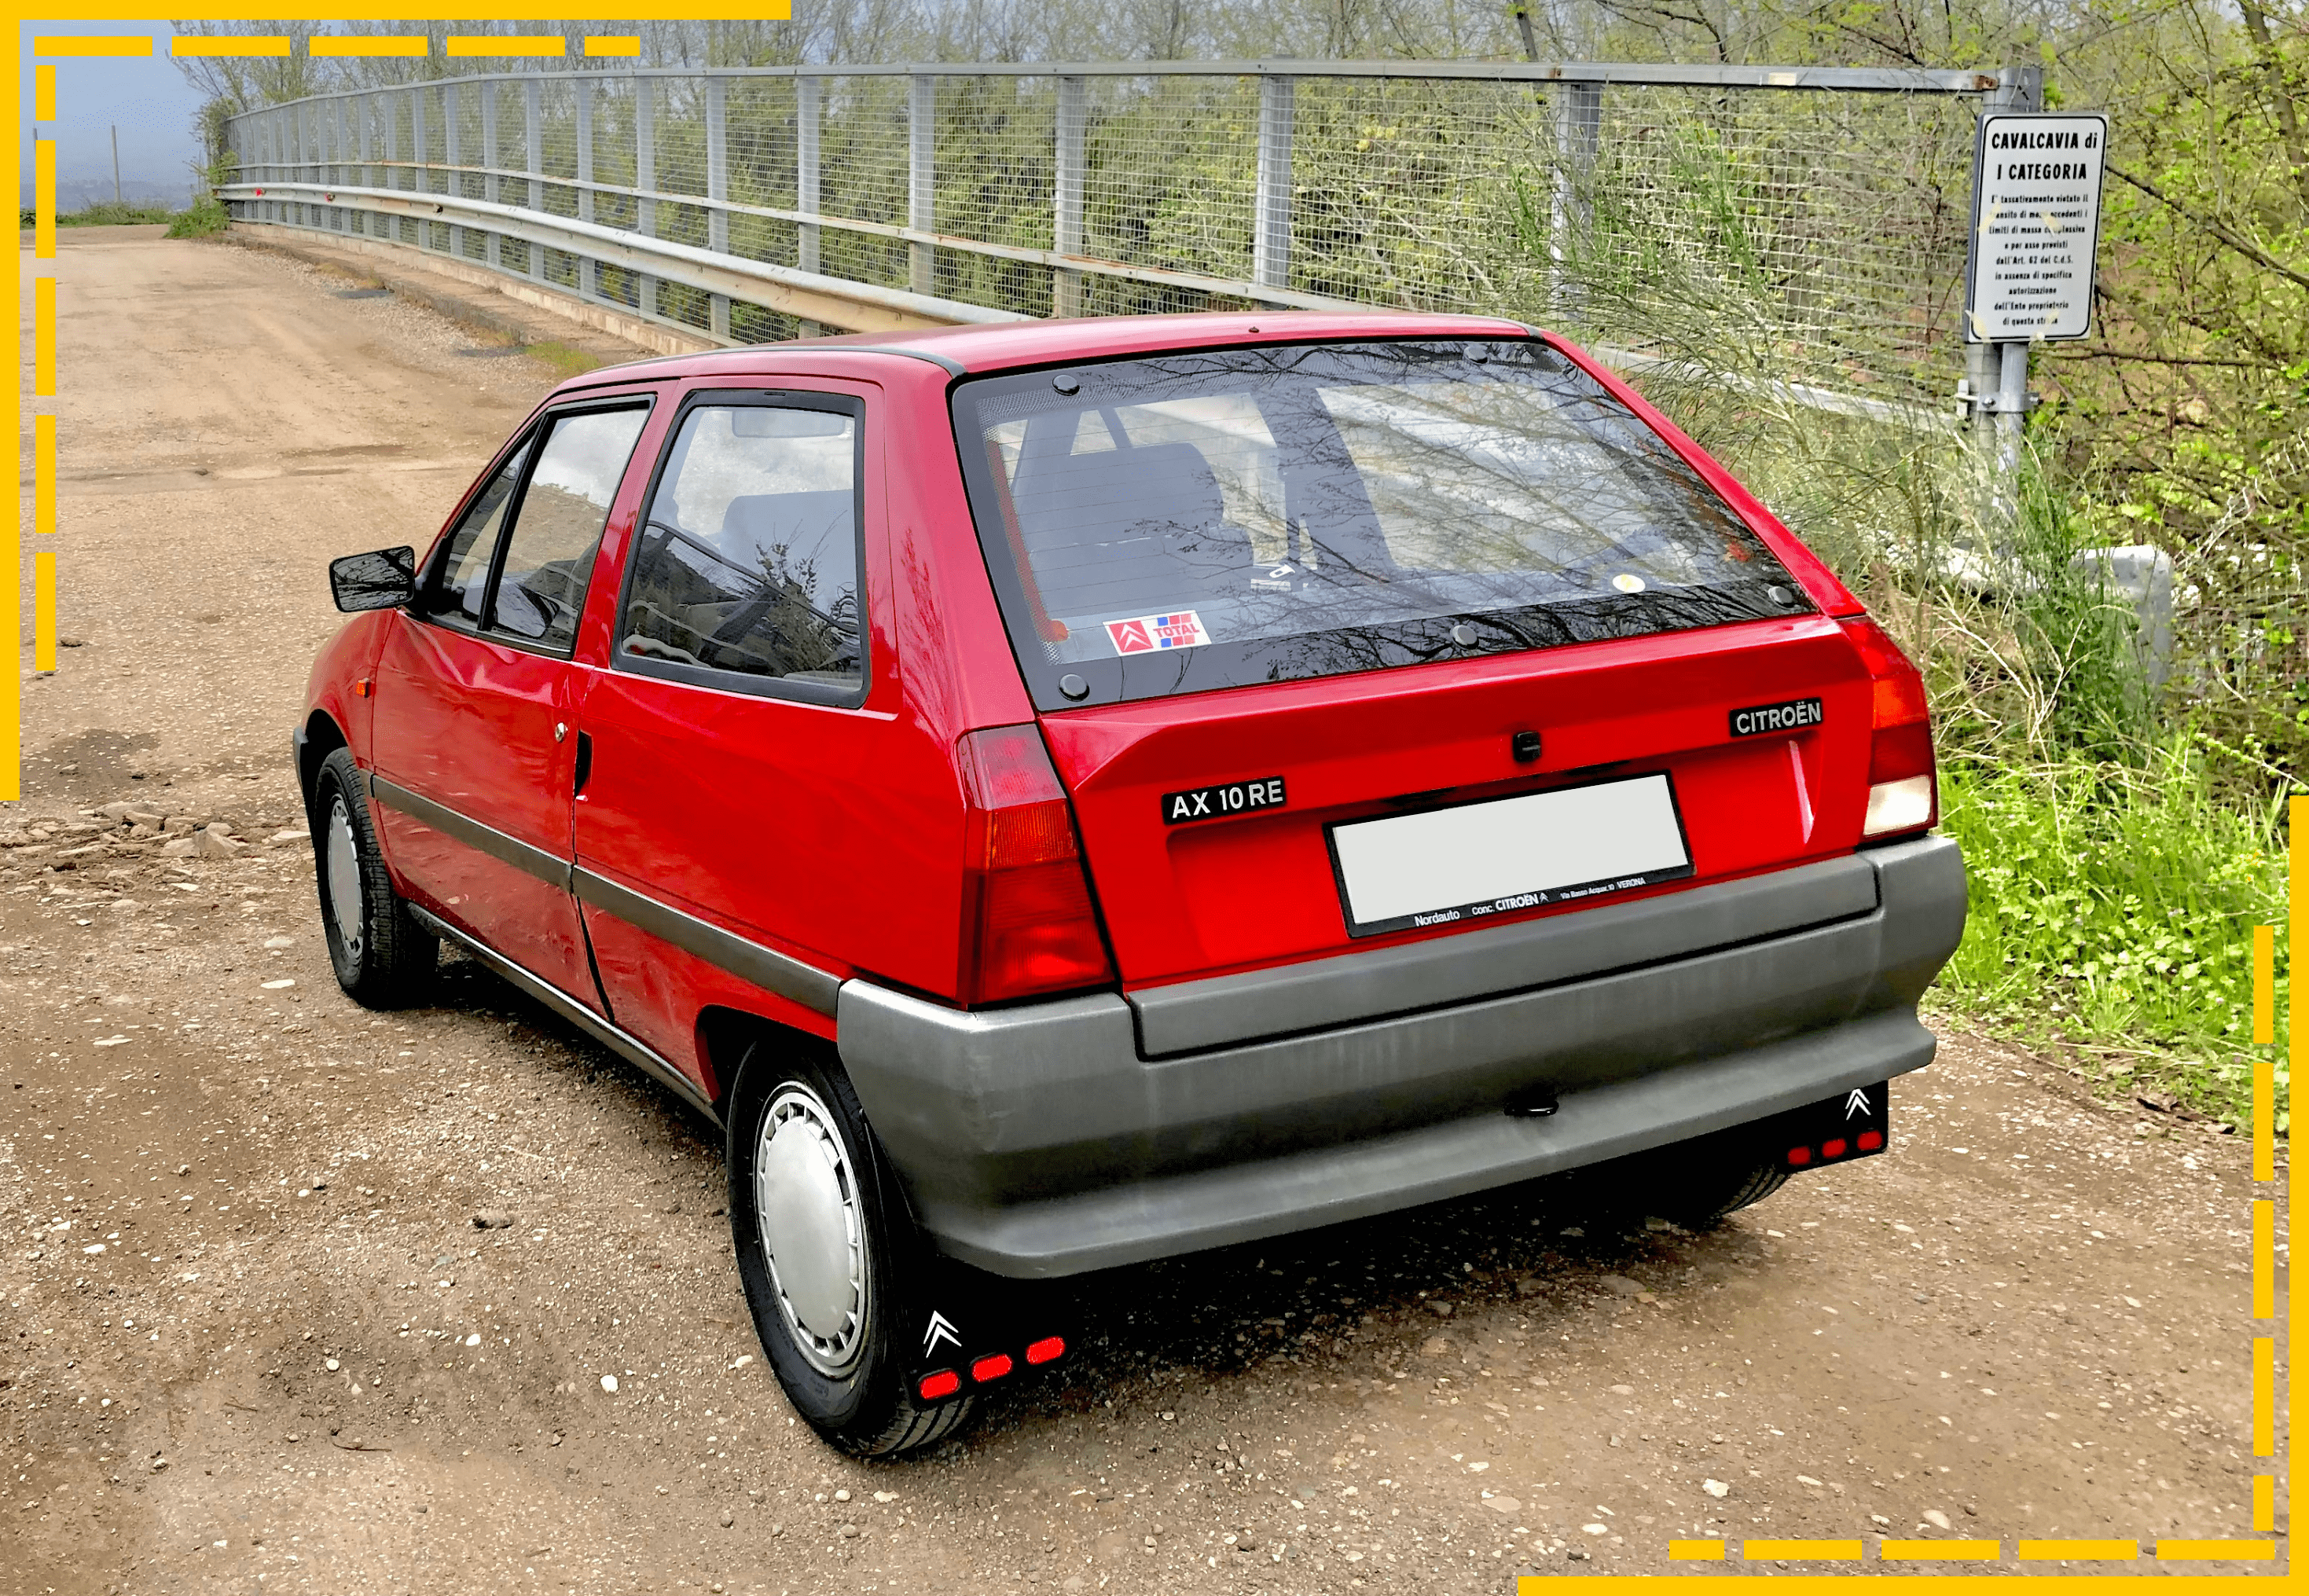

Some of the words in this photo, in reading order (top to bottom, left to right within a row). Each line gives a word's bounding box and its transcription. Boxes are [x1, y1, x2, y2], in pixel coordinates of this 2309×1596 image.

[1991, 132, 2079, 149] CAVALCAVIA
[2084, 132, 2098, 149] di
[1997, 163, 2002, 180] I
[2009, 163, 2087, 179] CATEGORIA
[2001, 195, 2054, 204] tassativamente
[2056, 194, 2080, 203] vietato
[2083, 194, 2088, 203] il
[1989, 210, 2017, 218] ansito
[2020, 210, 2027, 218] di
[1989, 226, 2010, 234] limiti
[2012, 225, 2018, 234] di
[2011, 242, 2022, 251] per
[2042, 240, 2069, 250] previsti
[2040, 255, 2051, 264] del
[2054, 255, 2073, 264] C.d.S.
[1995, 272, 2002, 281] in
[2033, 271, 2039, 280] di
[2042, 270, 2072, 280] specifica
[2009, 285, 2057, 295] autorizzazione
[1994, 301, 2026, 310] dell'Ente
[2002, 317, 2009, 326] di
[2012, 317, 2034, 328] questa
[2037, 316, 2058, 325] stra
[1152, 622, 1200, 638] TOTAL
[1736, 701, 1821, 733] CITROËN
[1172, 791, 1211, 819] AX
[1219, 787, 1243, 811] 10
[1248, 780, 1283, 806] RE
[1570, 890, 1588, 898] Basso
[1616, 876, 1646, 890] VERONA
[1414, 909, 1461, 926] Nordauto
[1495, 893, 1540, 911] CITROËN
